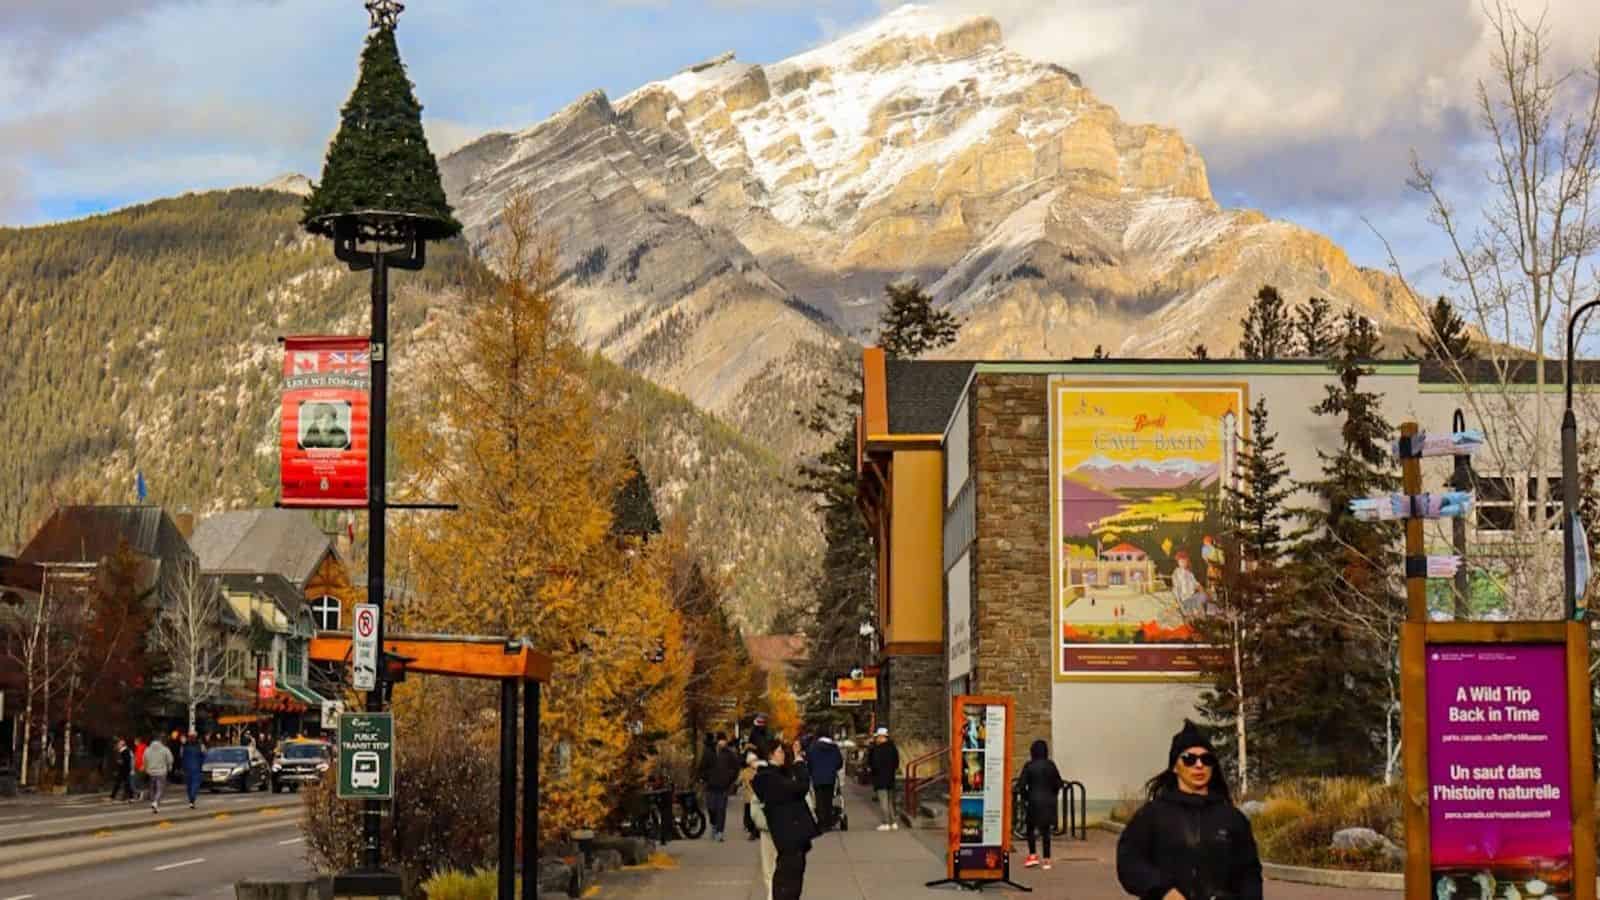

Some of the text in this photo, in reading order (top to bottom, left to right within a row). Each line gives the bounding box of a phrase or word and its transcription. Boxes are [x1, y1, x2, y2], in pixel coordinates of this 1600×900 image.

[1154, 431, 1208, 450] BASIN
[1456, 686, 1532, 704] A Wild Trip
[1449, 707, 1540, 722] Back in Time
[354, 733, 378, 741] PUBLIC
[342, 741, 390, 750] TRANSIT STOP
[1450, 765, 1542, 780] Un saut dans
[1433, 785, 1560, 801] l'histoire naturelle
